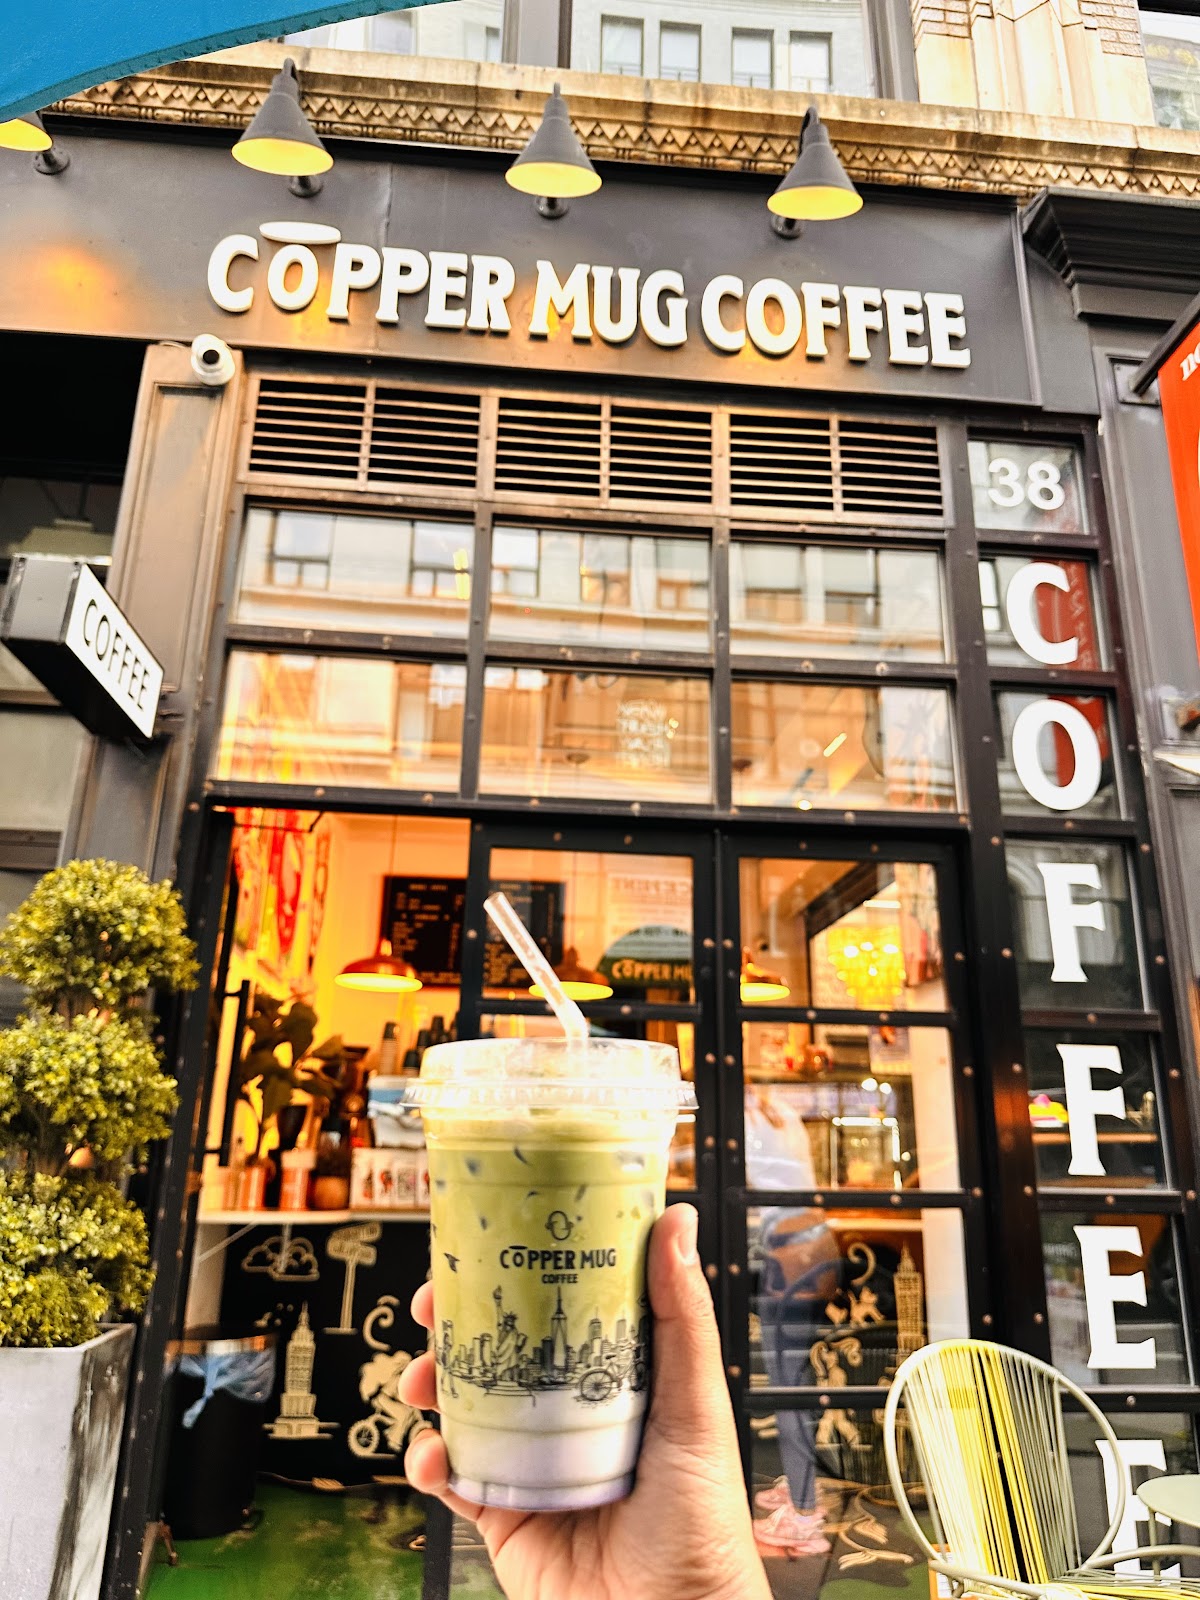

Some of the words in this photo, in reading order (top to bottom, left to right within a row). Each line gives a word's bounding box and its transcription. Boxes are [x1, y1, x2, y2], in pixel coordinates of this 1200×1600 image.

[528, 260, 689, 347] MUG
[701, 274, 971, 369] COFFEE
[987, 457, 1066, 511] 38
[82, 598, 150, 711] COFFEE
[1006, 562, 1181, 1586] COFFEE
[541, 1273, 578, 1284] COFFEE
[579, 1248, 616, 1270] MUG
